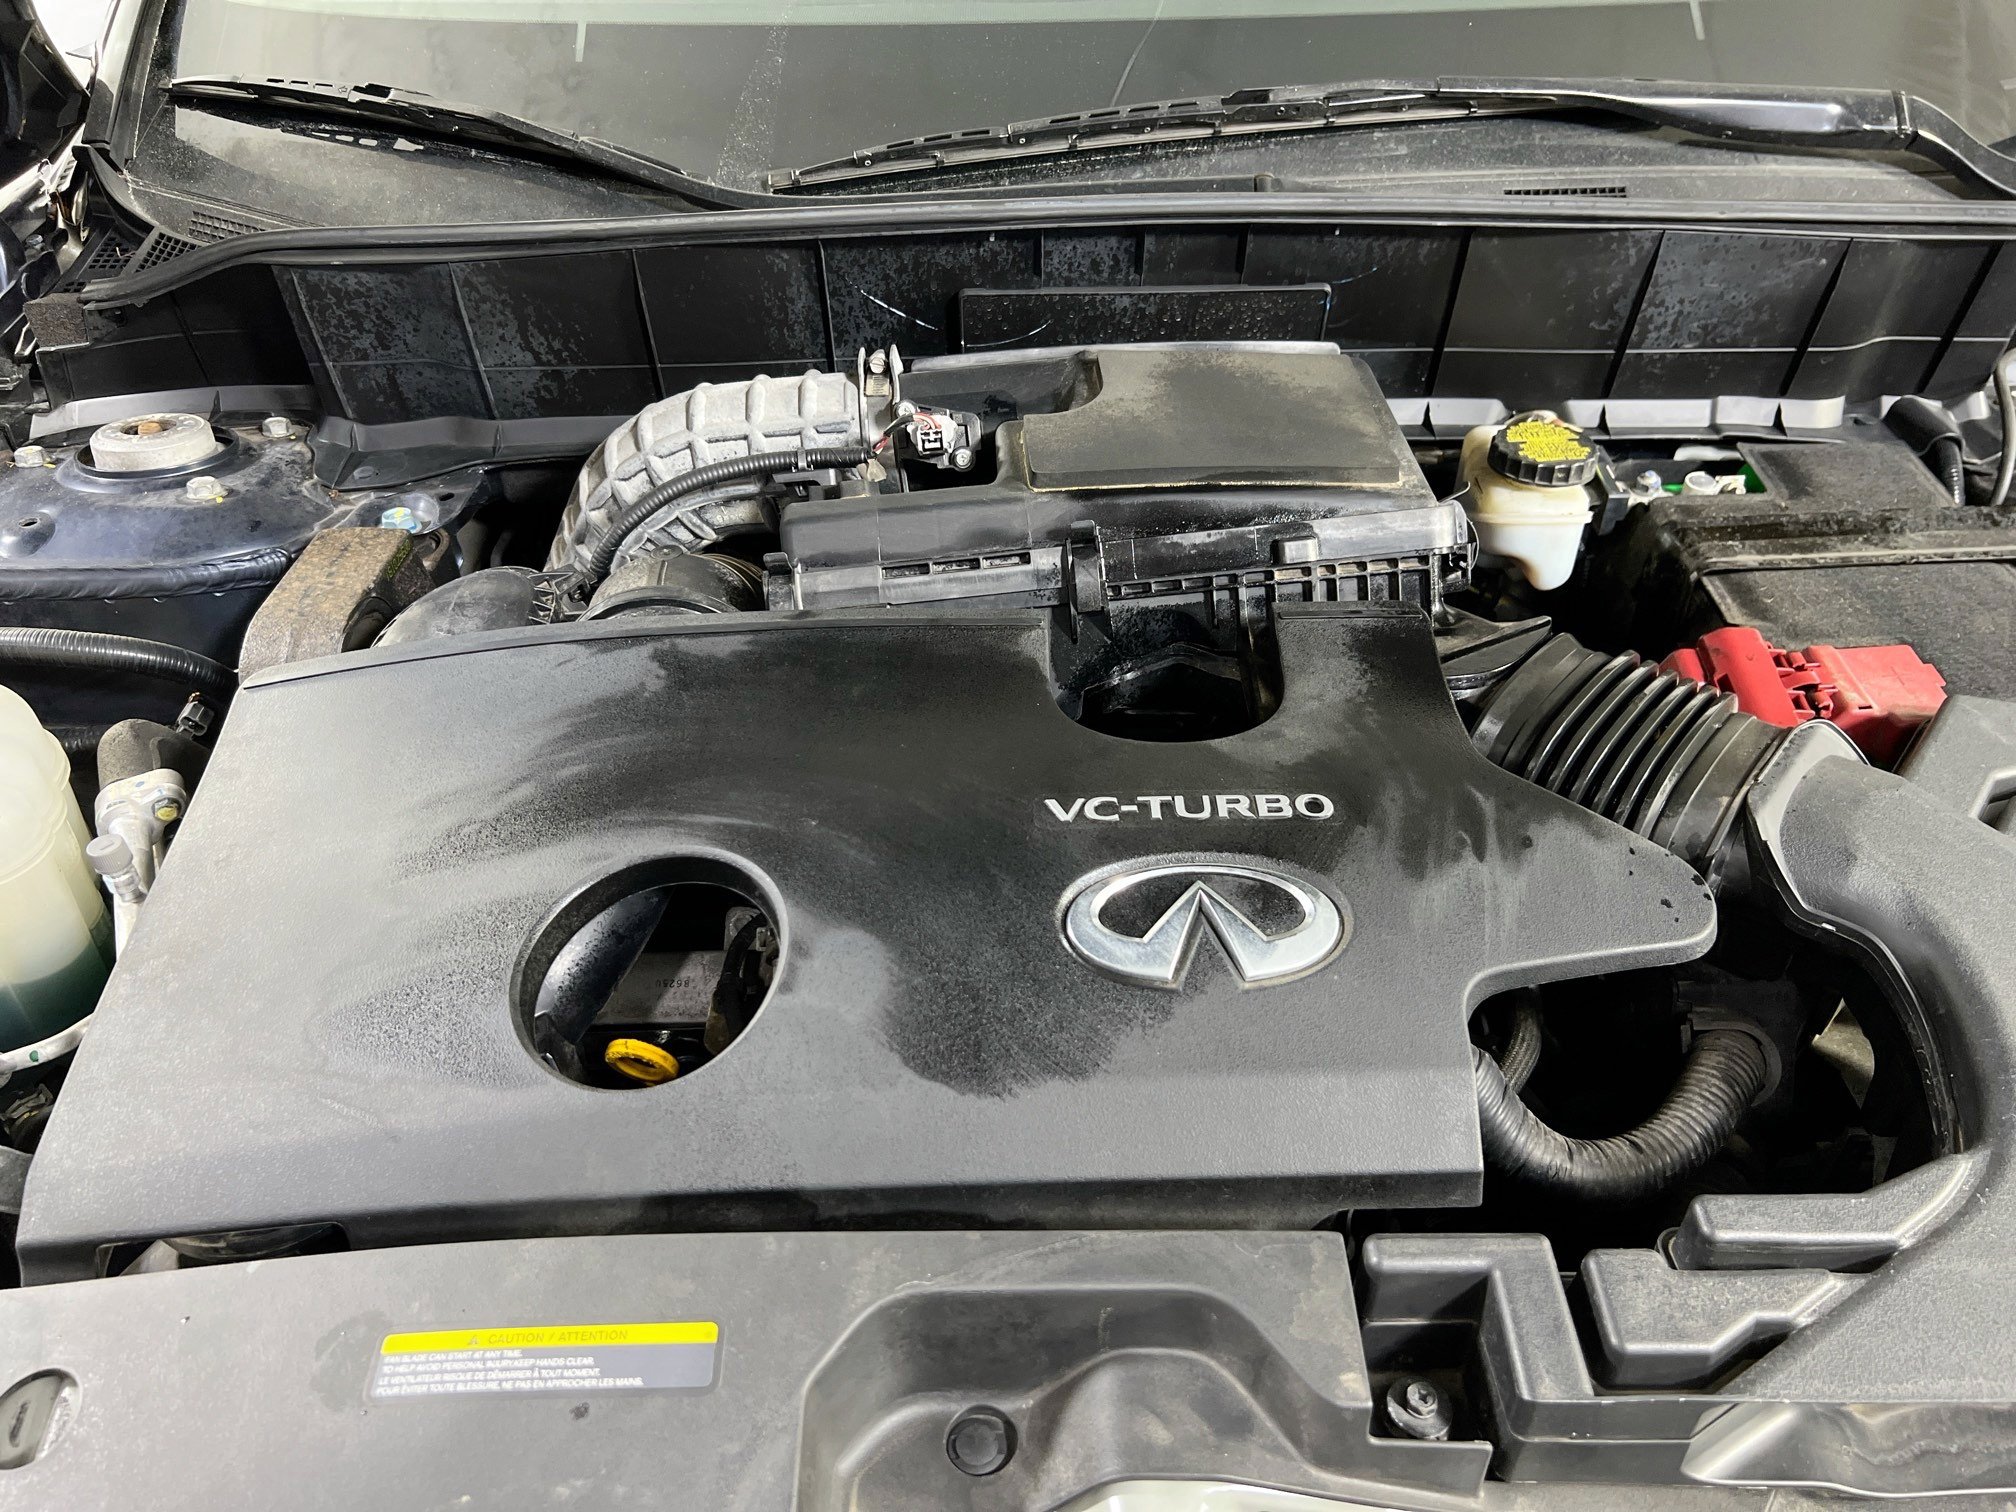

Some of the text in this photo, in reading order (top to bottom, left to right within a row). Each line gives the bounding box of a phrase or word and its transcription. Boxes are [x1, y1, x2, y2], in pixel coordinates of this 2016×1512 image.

[1044, 793, 1335, 822] VC-TURBO
[488, 1332, 545, 1345] CAUTION
[558, 1330, 628, 1342] ATTENTION
[428, 1352, 447, 1360] CAN
[447, 1351, 472, 1360] START
[474, 1350, 483, 1358] AT
[484, 1350, 501, 1358] ANY
[383, 1365, 394, 1373] TO
[395, 1364, 416, 1372] HELP
[416, 1363, 441, 1371] AVOID
[442, 1361, 485, 1370] PERSONAL
[537, 1358, 565, 1366] HANDS
[380, 1377, 390, 1385] LE
[475, 1372, 486, 1380] DE
[541, 1368, 562, 1377] TOUT
[376, 1386, 400, 1395] POUR
[429, 1382, 455, 1392] TOUTE
[502, 1381, 514, 1389] NE
[515, 1380, 531, 1389] PAS
[533, 1379, 545, 1388] EN
[546, 1378, 597, 1388] APPROCHER
[599, 1377, 614, 1386] LES
